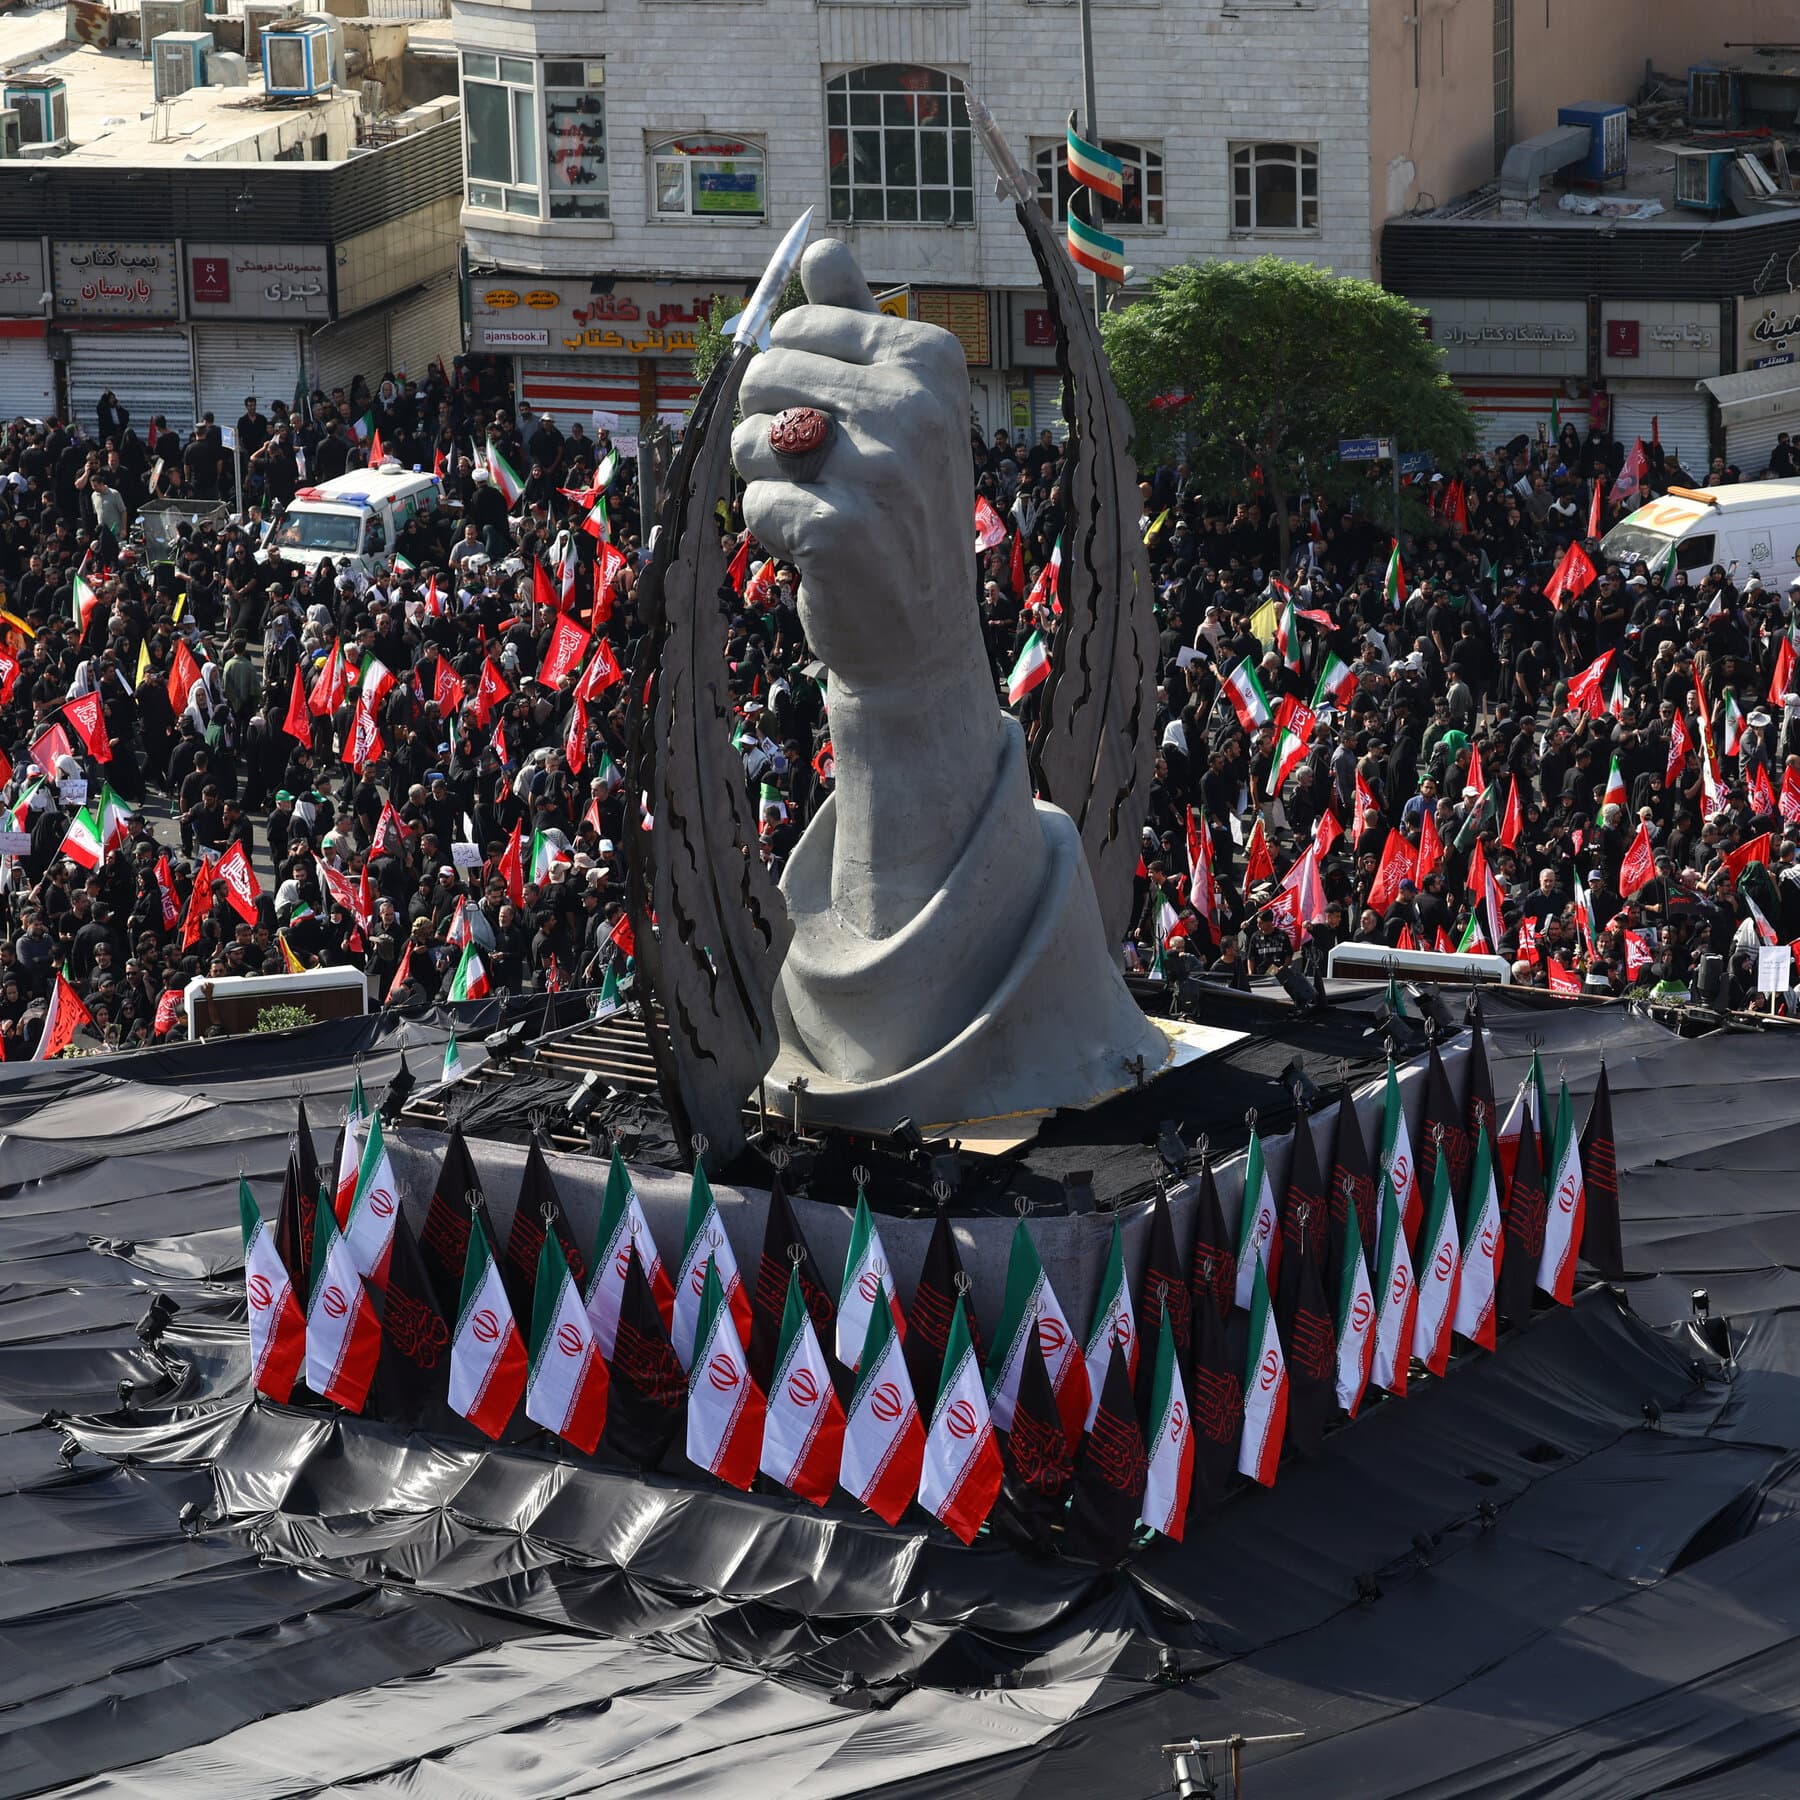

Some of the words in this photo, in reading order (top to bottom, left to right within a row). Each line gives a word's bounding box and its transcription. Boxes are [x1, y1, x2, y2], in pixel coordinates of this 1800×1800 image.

[70, 248, 118, 273] کتاب
[80, 276, 152, 303] پارسیان
[264, 275, 322, 302] خیری
[572, 294, 641, 328] کتاب
[485, 331, 546, 342] ajansbook.ir
[562, 328, 625, 352] کتاب
[1443, 327, 1465, 344] راد
[1464, 327, 1504, 345] کتاب
[1504, 325, 1577, 347] نمایشگاه
